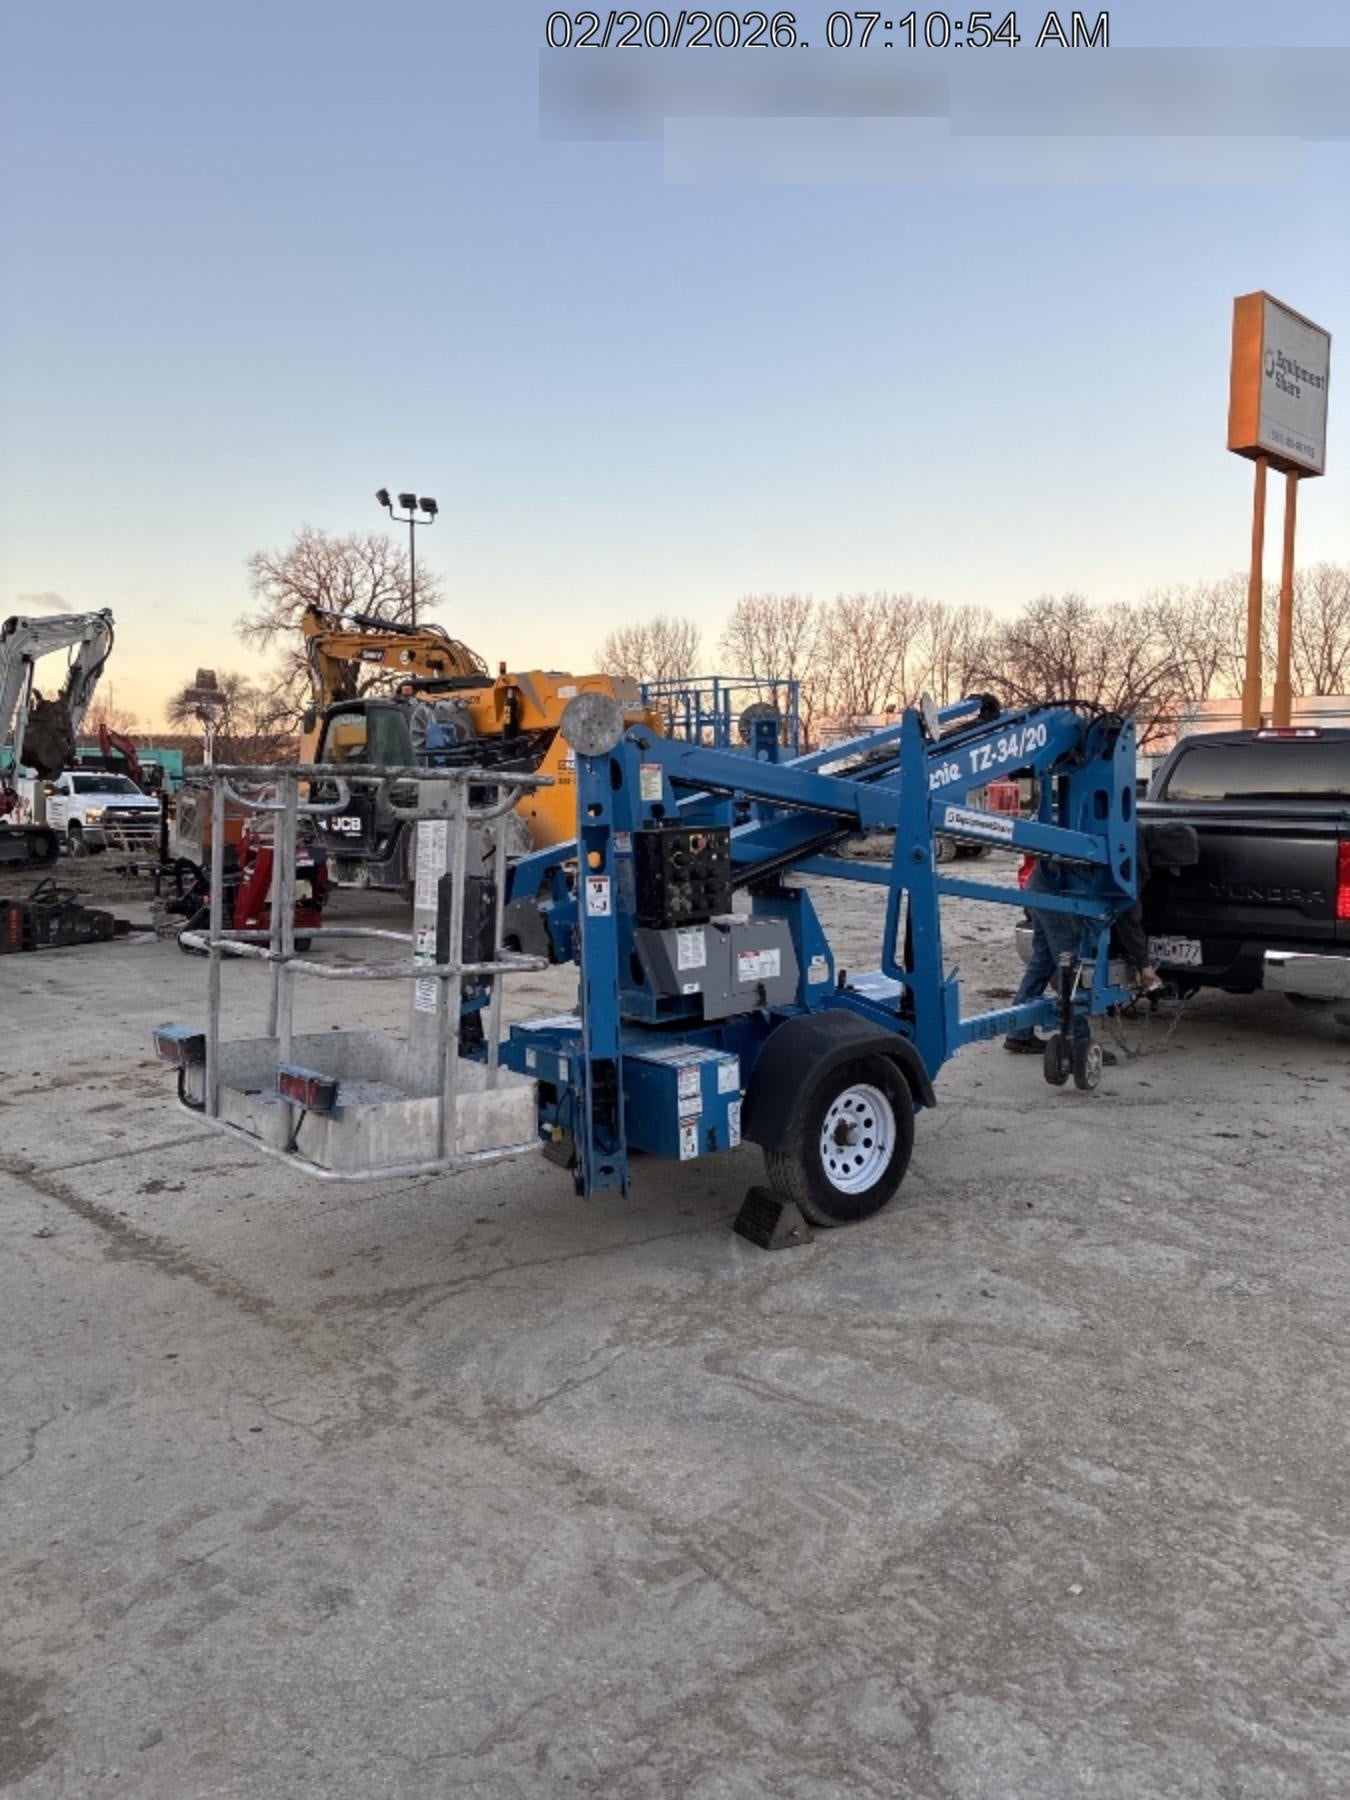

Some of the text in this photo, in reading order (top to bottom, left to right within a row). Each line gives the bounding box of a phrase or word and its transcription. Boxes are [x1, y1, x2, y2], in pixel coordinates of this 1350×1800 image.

[1275, 371, 1301, 399] Share
[969, 723, 1047, 775] TZ-34/20
[331, 816, 361, 831] JCB
